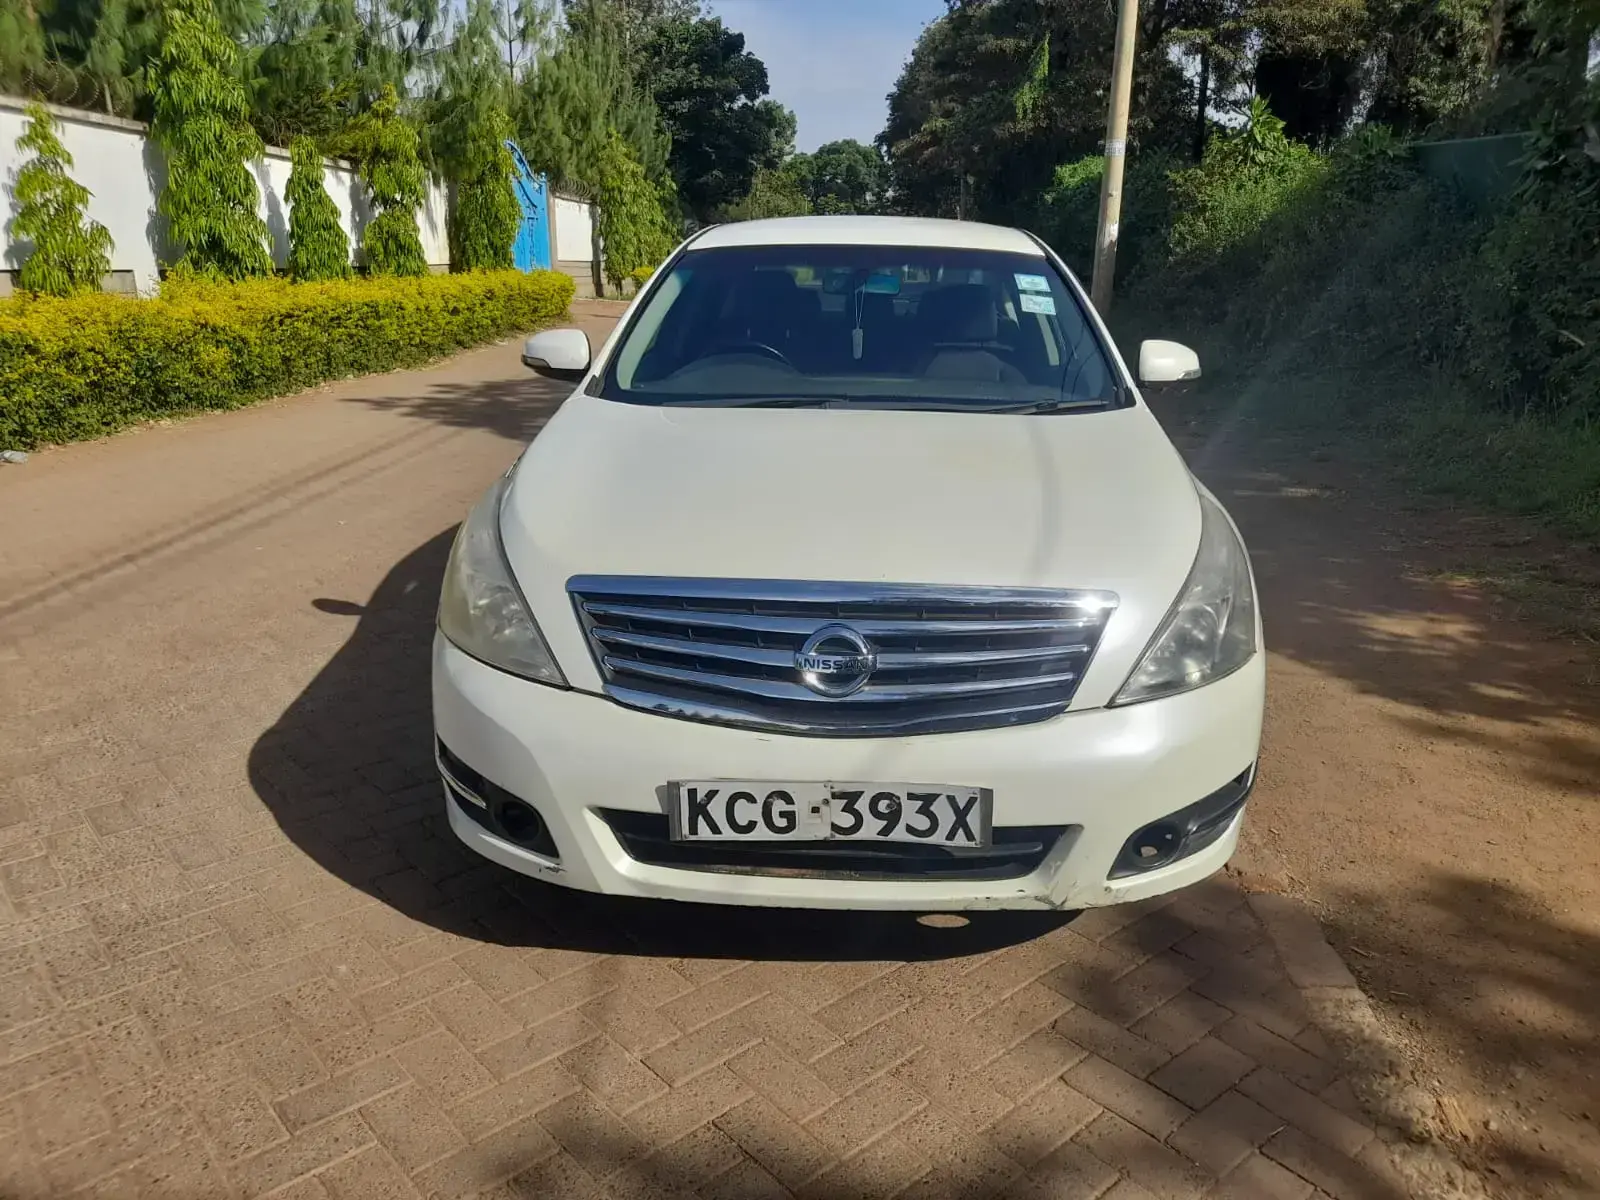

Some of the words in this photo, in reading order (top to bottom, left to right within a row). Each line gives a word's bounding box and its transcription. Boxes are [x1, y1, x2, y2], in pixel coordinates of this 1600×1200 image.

[803, 658, 868, 670] NISSAN
[687, 788, 796, 835] KCG
[831, 791, 979, 841] 393X
